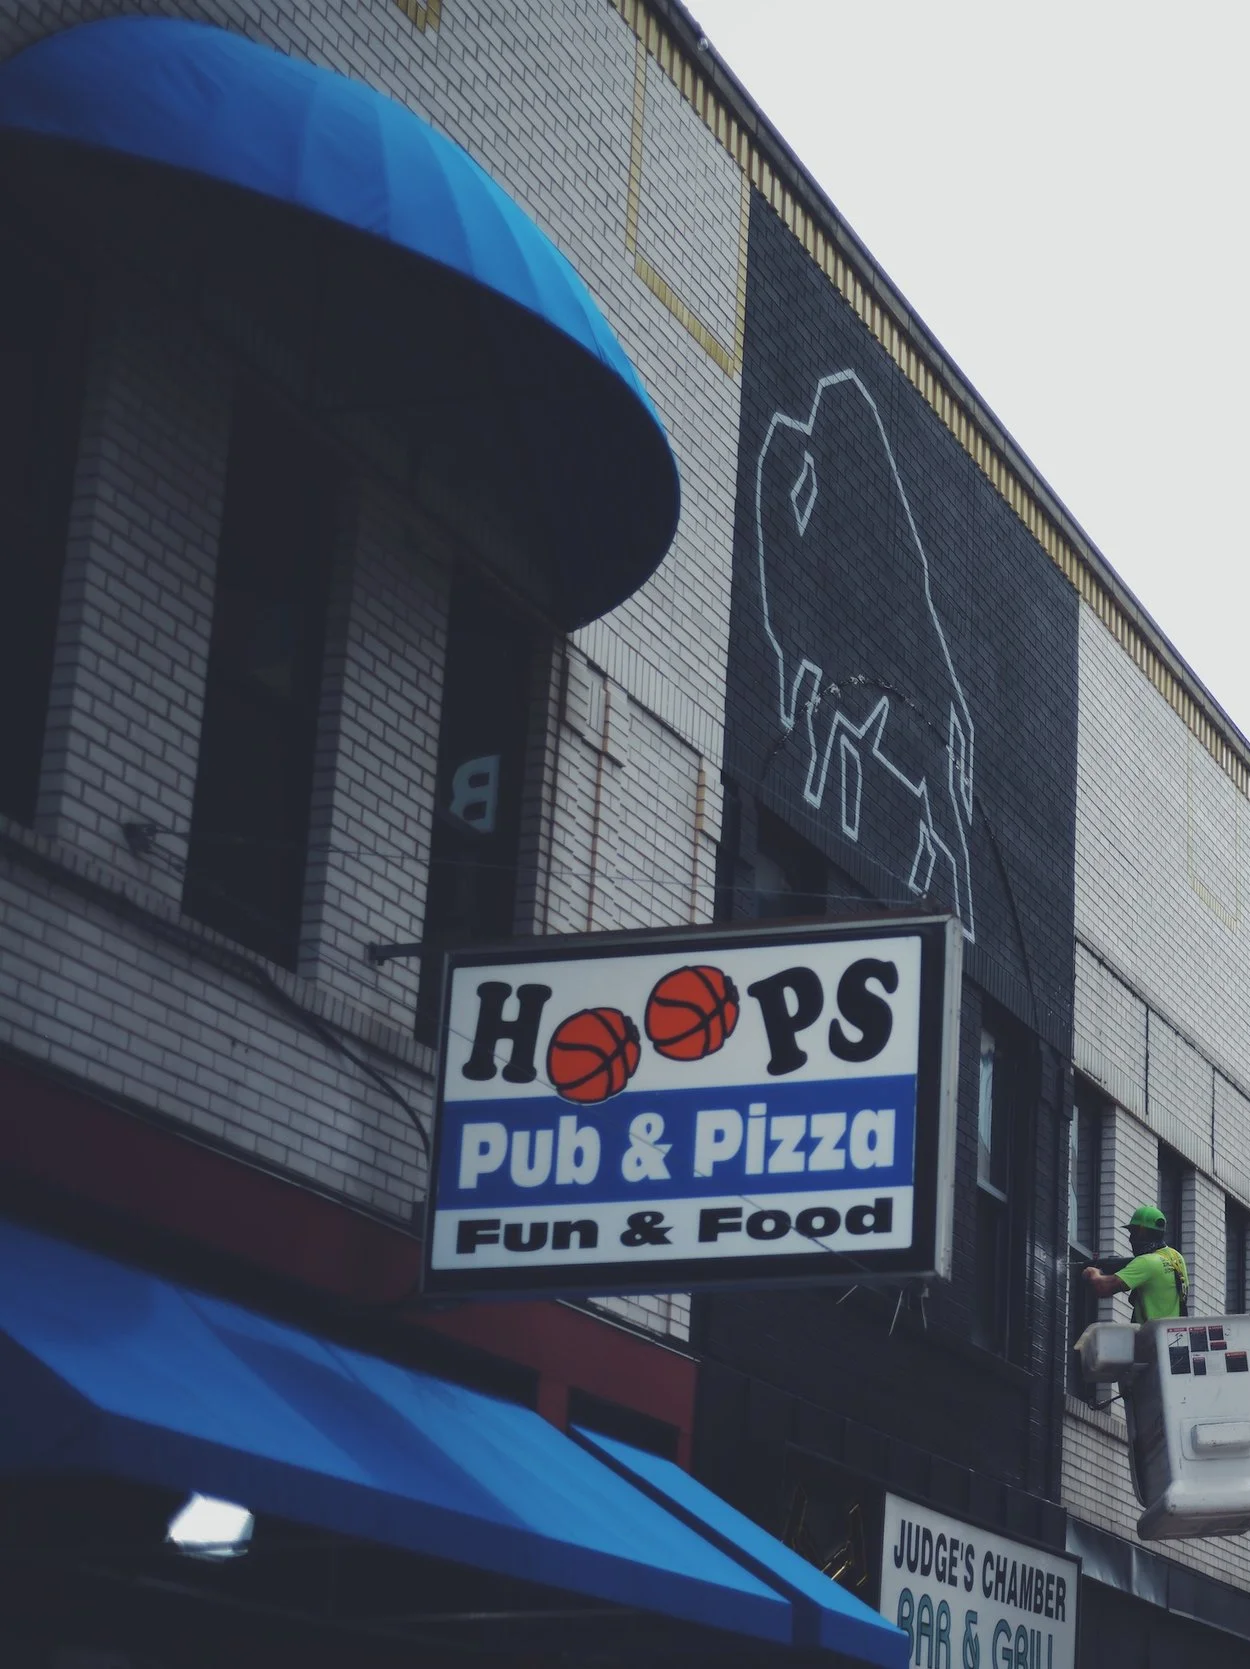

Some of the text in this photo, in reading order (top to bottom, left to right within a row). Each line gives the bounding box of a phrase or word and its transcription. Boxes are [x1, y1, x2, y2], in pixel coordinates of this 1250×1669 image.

[458, 1103, 895, 1189] Pub & Pizza
[455, 1197, 893, 1254] Fun & Food
[894, 1519, 1066, 1622] JUDGE'S CHAMBER
[897, 1587, 951, 1669] BAR
[962, 1609, 980, 1669] &
